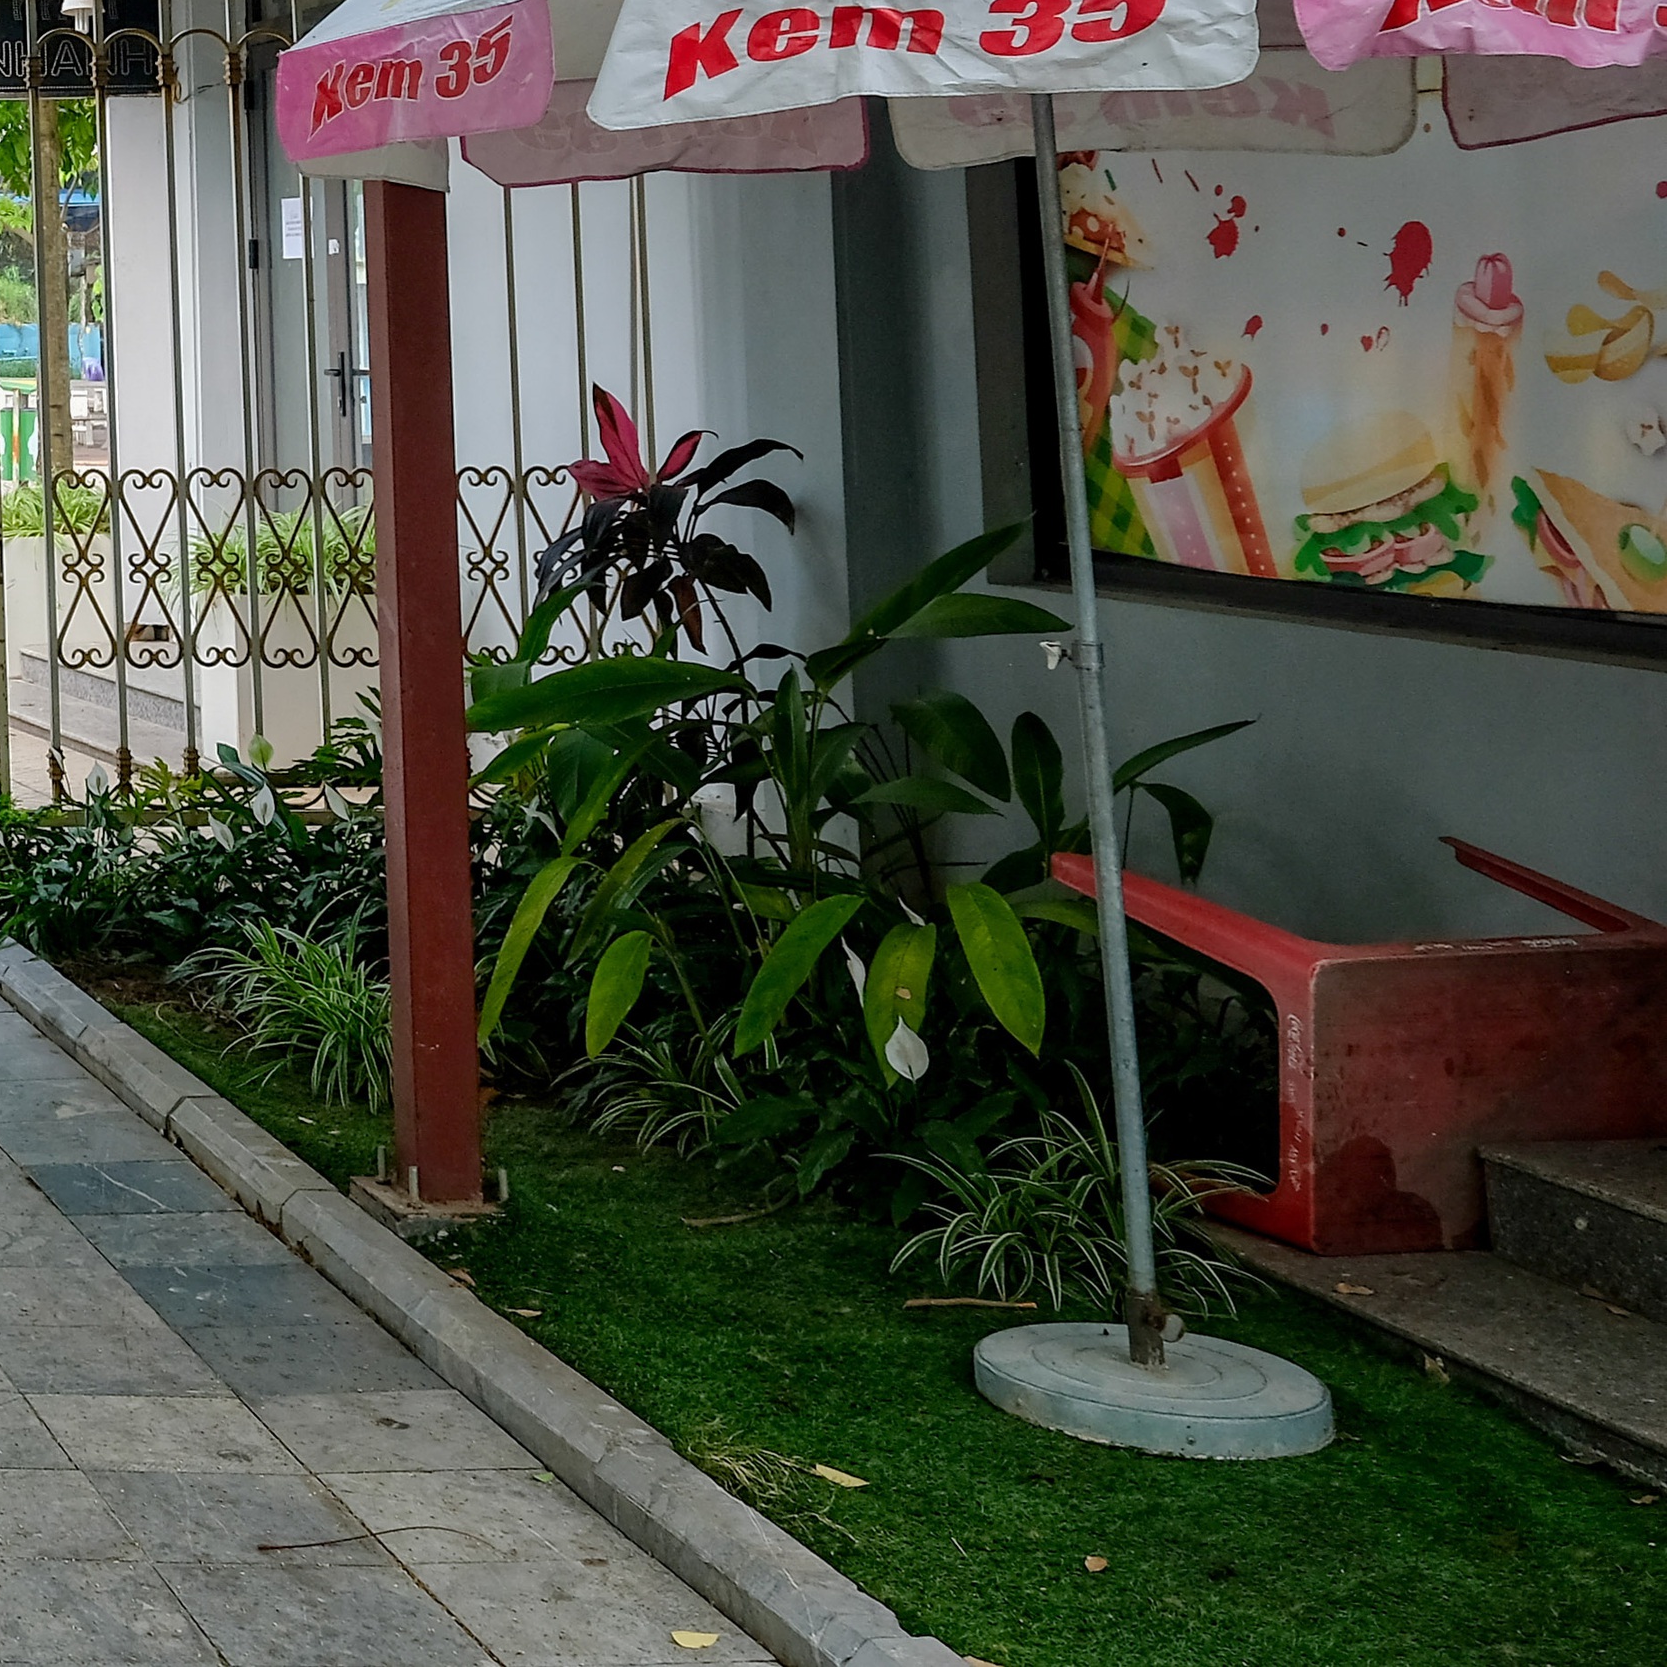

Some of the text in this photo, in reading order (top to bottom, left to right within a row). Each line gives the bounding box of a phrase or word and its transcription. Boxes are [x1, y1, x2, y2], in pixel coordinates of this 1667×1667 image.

[307, 51, 424, 143] Kem
[433, 14, 515, 101] 35
[661, 4, 946, 102] Kem
